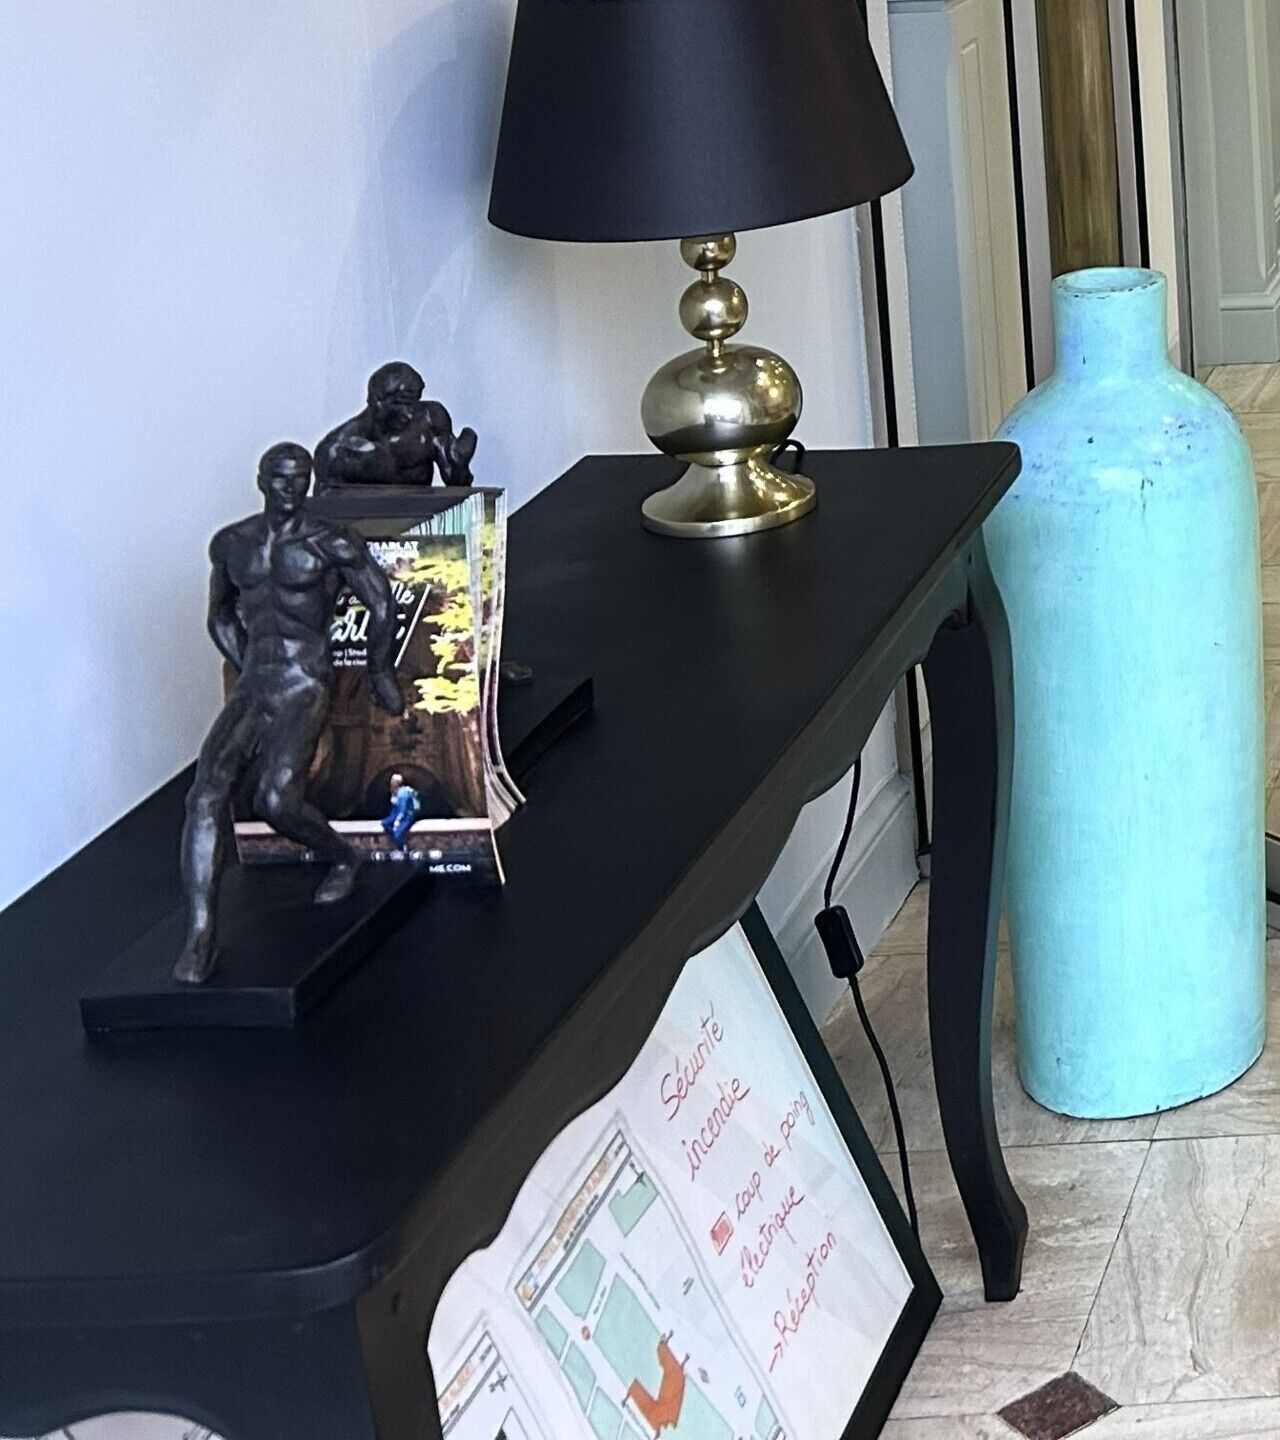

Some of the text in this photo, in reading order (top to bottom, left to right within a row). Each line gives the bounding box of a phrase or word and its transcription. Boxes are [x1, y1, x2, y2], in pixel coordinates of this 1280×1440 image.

[659, 1001, 726, 1121] Sécurité
[680, 1075, 752, 1182] incendie
[734, 1089, 816, 1223] coup de poing
[772, 1231, 838, 1335] Réception
